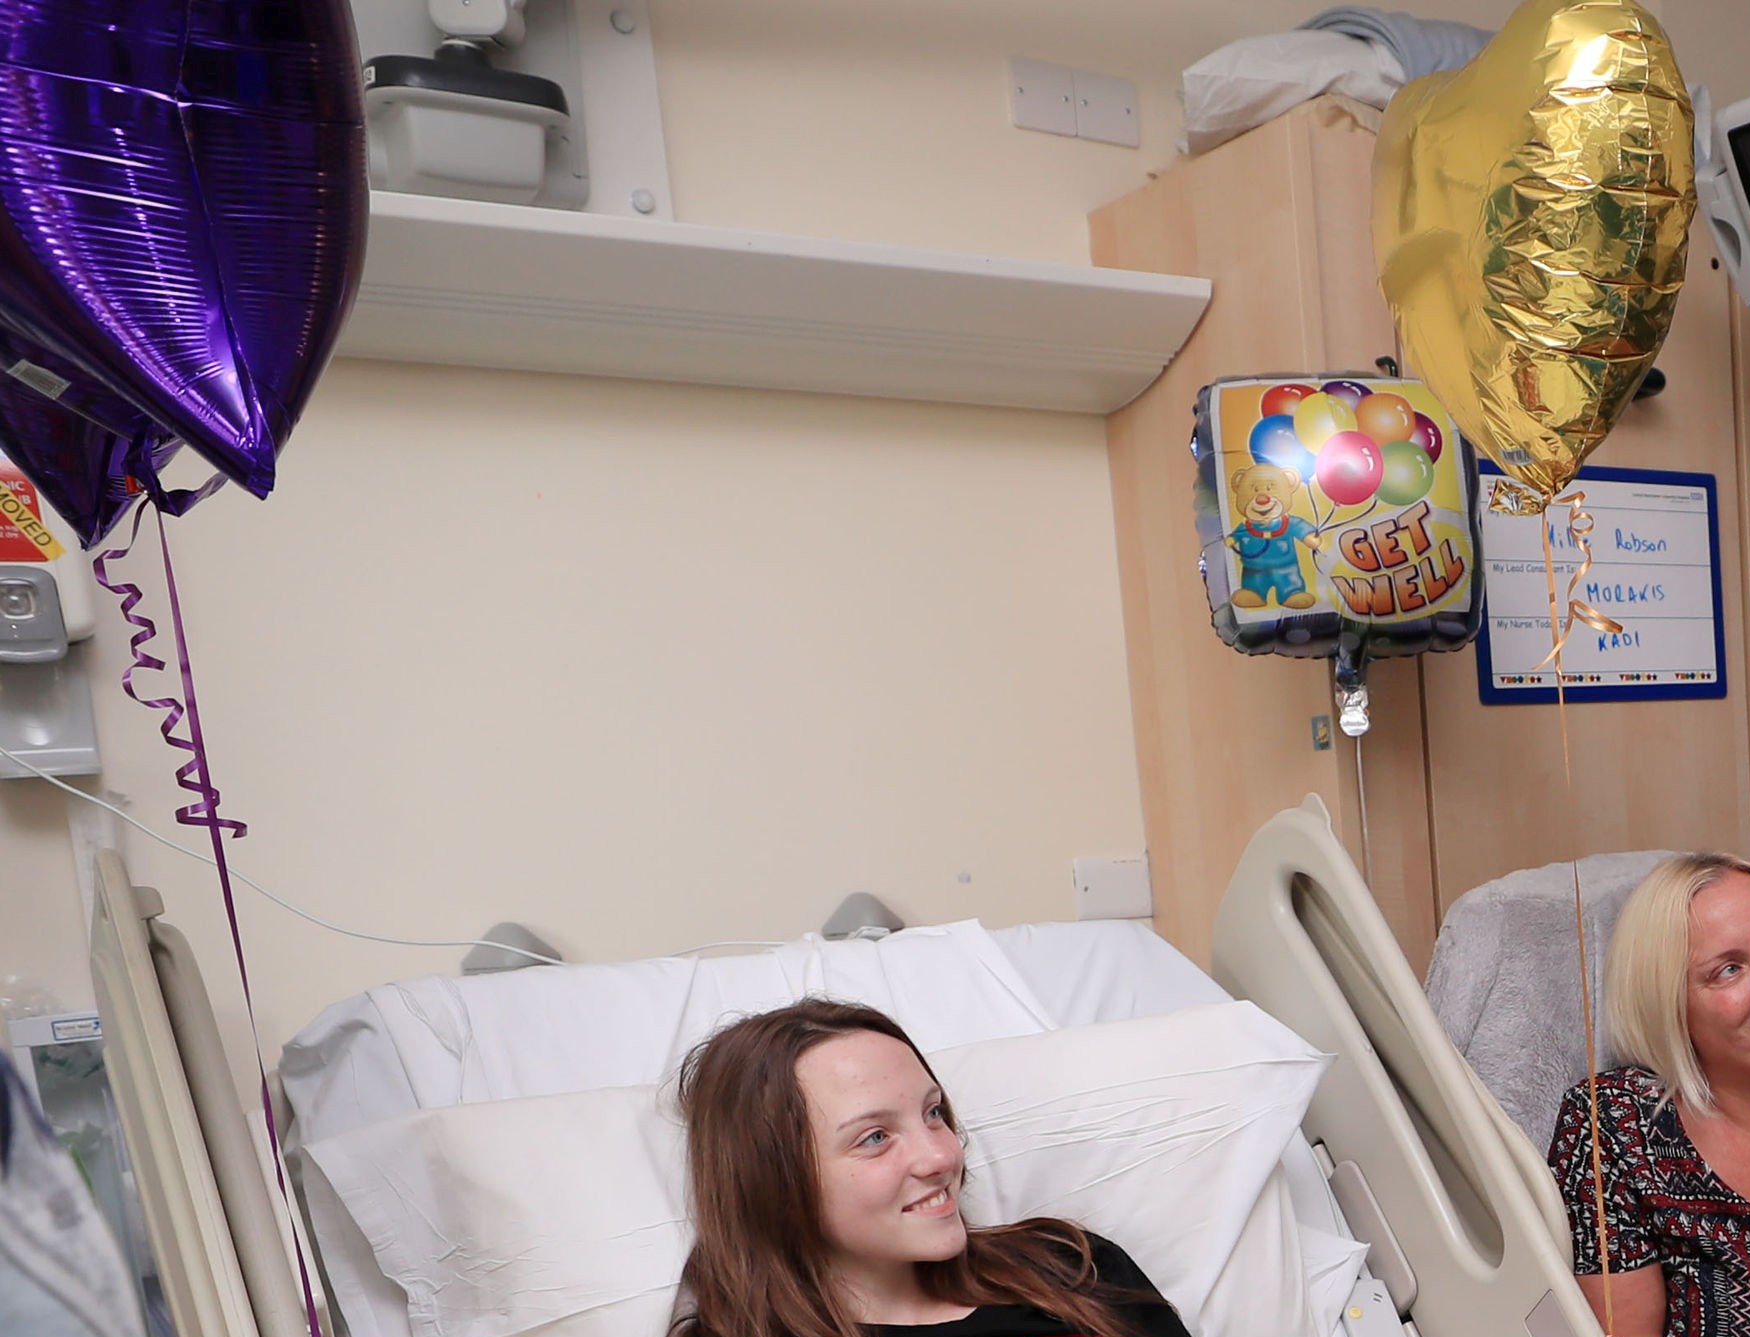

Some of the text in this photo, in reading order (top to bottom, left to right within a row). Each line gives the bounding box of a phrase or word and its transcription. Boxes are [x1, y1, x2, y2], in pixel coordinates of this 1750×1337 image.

[1339, 500, 1431, 572] GET
[1615, 528, 1668, 553] Robson
[1331, 539, 1465, 616] WELL
[1493, 564, 1504, 574] My
[1506, 564, 1524, 573] Lead
[1497, 620, 1508, 629] My
[1510, 620, 1532, 628] Nurse
